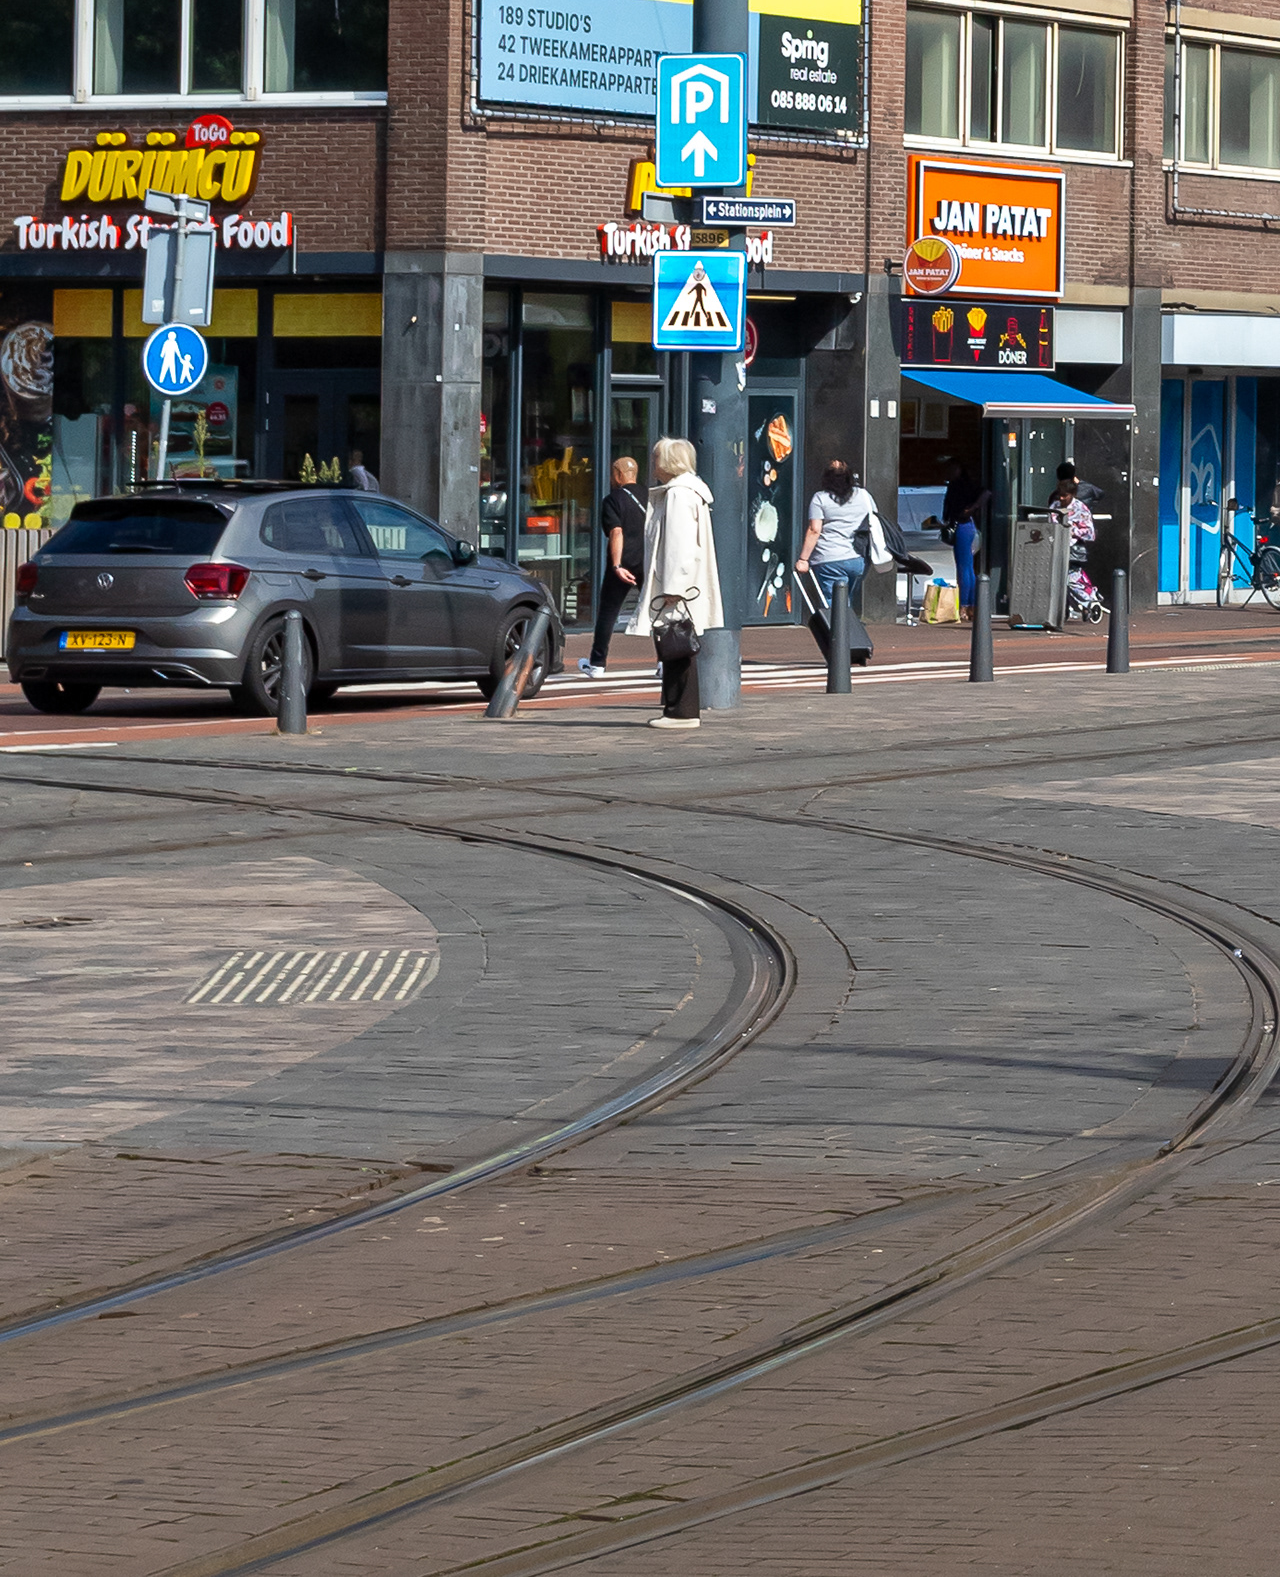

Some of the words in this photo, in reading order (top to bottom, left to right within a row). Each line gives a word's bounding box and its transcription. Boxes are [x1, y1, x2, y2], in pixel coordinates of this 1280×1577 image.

[498, 6, 524, 27] 189
[527, 9, 592, 33] STUDIO'S
[497, 34, 516, 53] 42
[520, 36, 666, 69] TWEEKAMERAPPART
[497, 62, 515, 82] 24
[789, 67, 808, 81] real
[809, 68, 838, 85] estate
[771, 89, 793, 109] 085
[794, 91, 817, 111] 888
[818, 94, 833, 112] 06
[833, 95, 847, 114] 14
[718, 201, 782, 221] Stationsplein
[933, 199, 980, 233] JAN
[985, 203, 1052, 238] PATAT
[13, 213, 119, 250] Turkish
[222, 211, 293, 249] Food
[603, 222, 671, 257] Turkish
[745, 231, 773, 264] ood
[983, 247, 991, 261] &
[992, 247, 1025, 263] Snacks
[908, 268, 924, 276] JAN
[925, 268, 950, 276] PATAT
[998, 347, 1027, 365] DÖNER
[71, 632, 128, 646] XV-123-N
